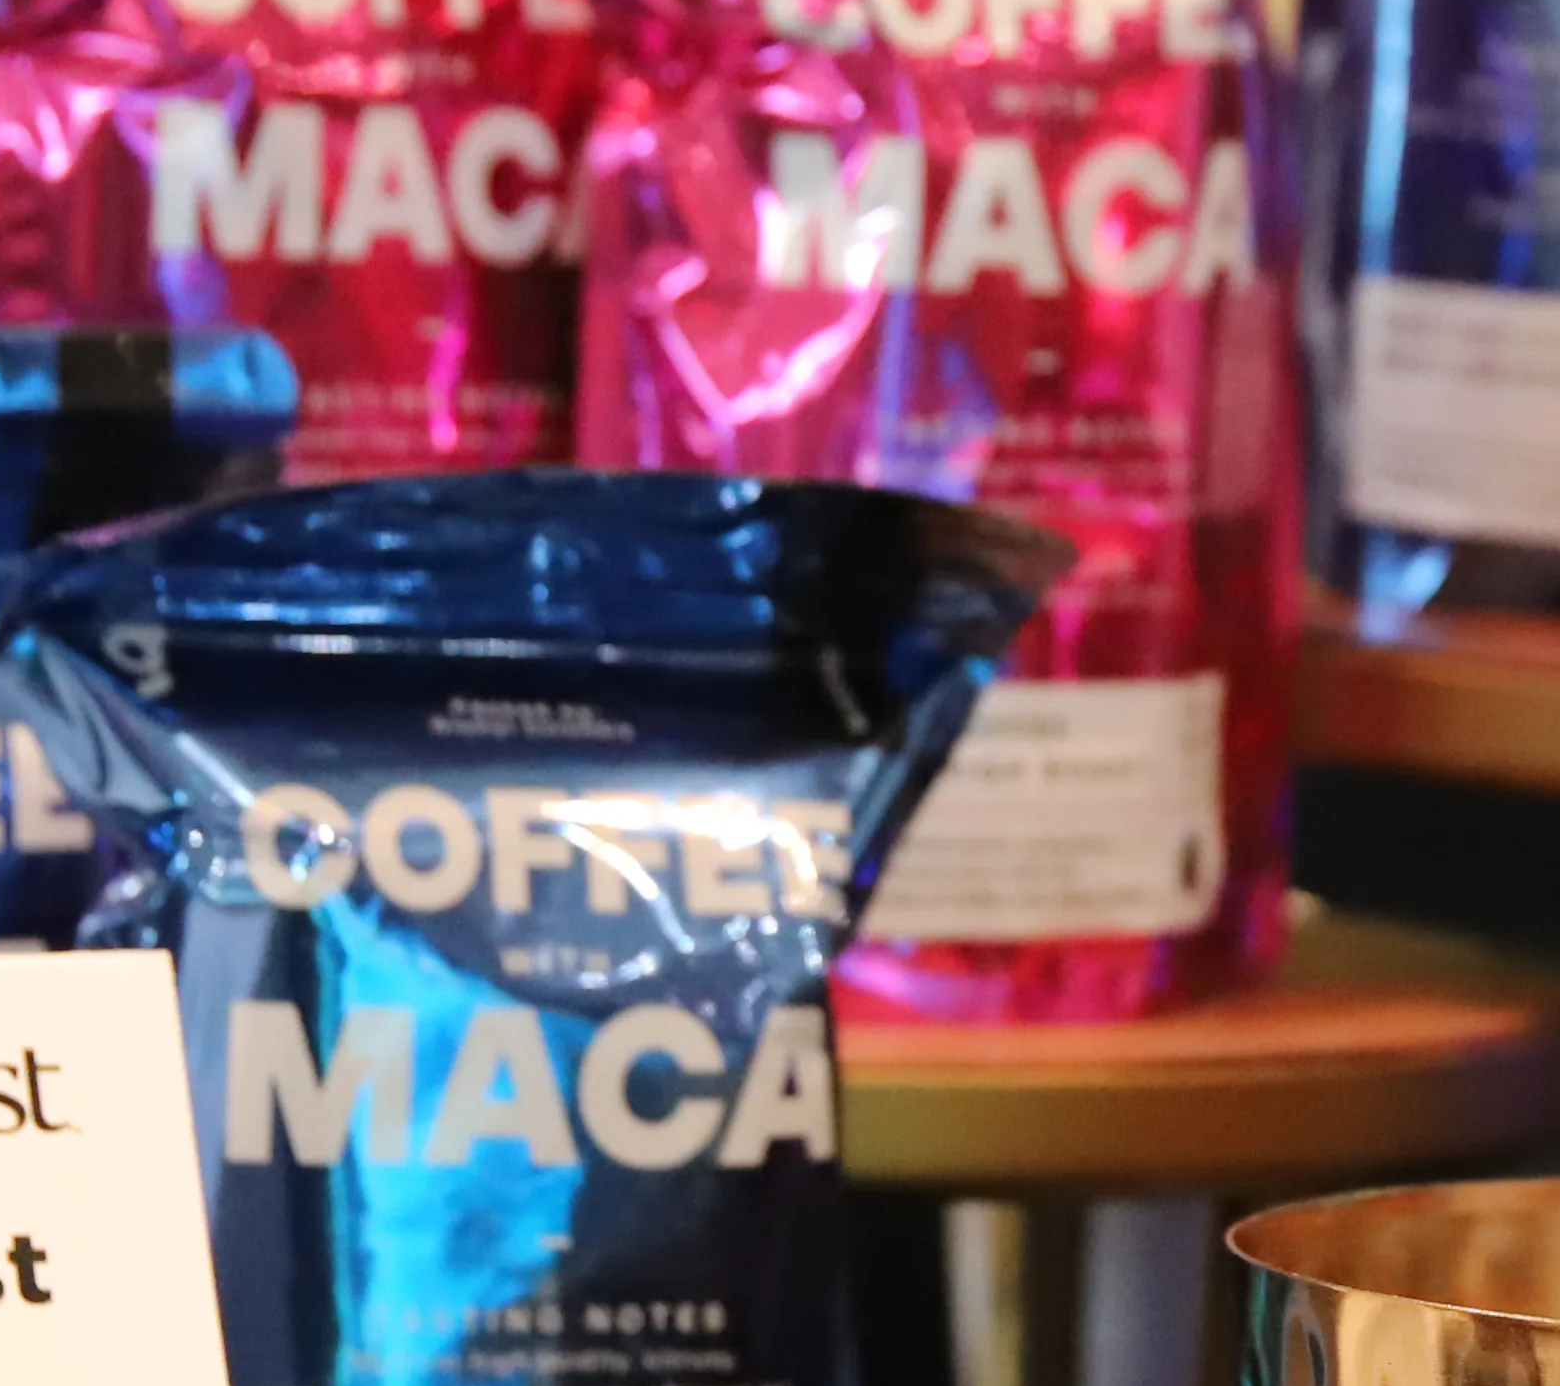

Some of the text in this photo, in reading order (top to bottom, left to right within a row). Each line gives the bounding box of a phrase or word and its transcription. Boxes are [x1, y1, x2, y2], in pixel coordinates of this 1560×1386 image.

[150, 101, 586, 264] MAC
[758, 133, 1255, 299] MACA
[244, 783, 853, 918] COFFEE
[223, 999, 839, 1168] MACA
